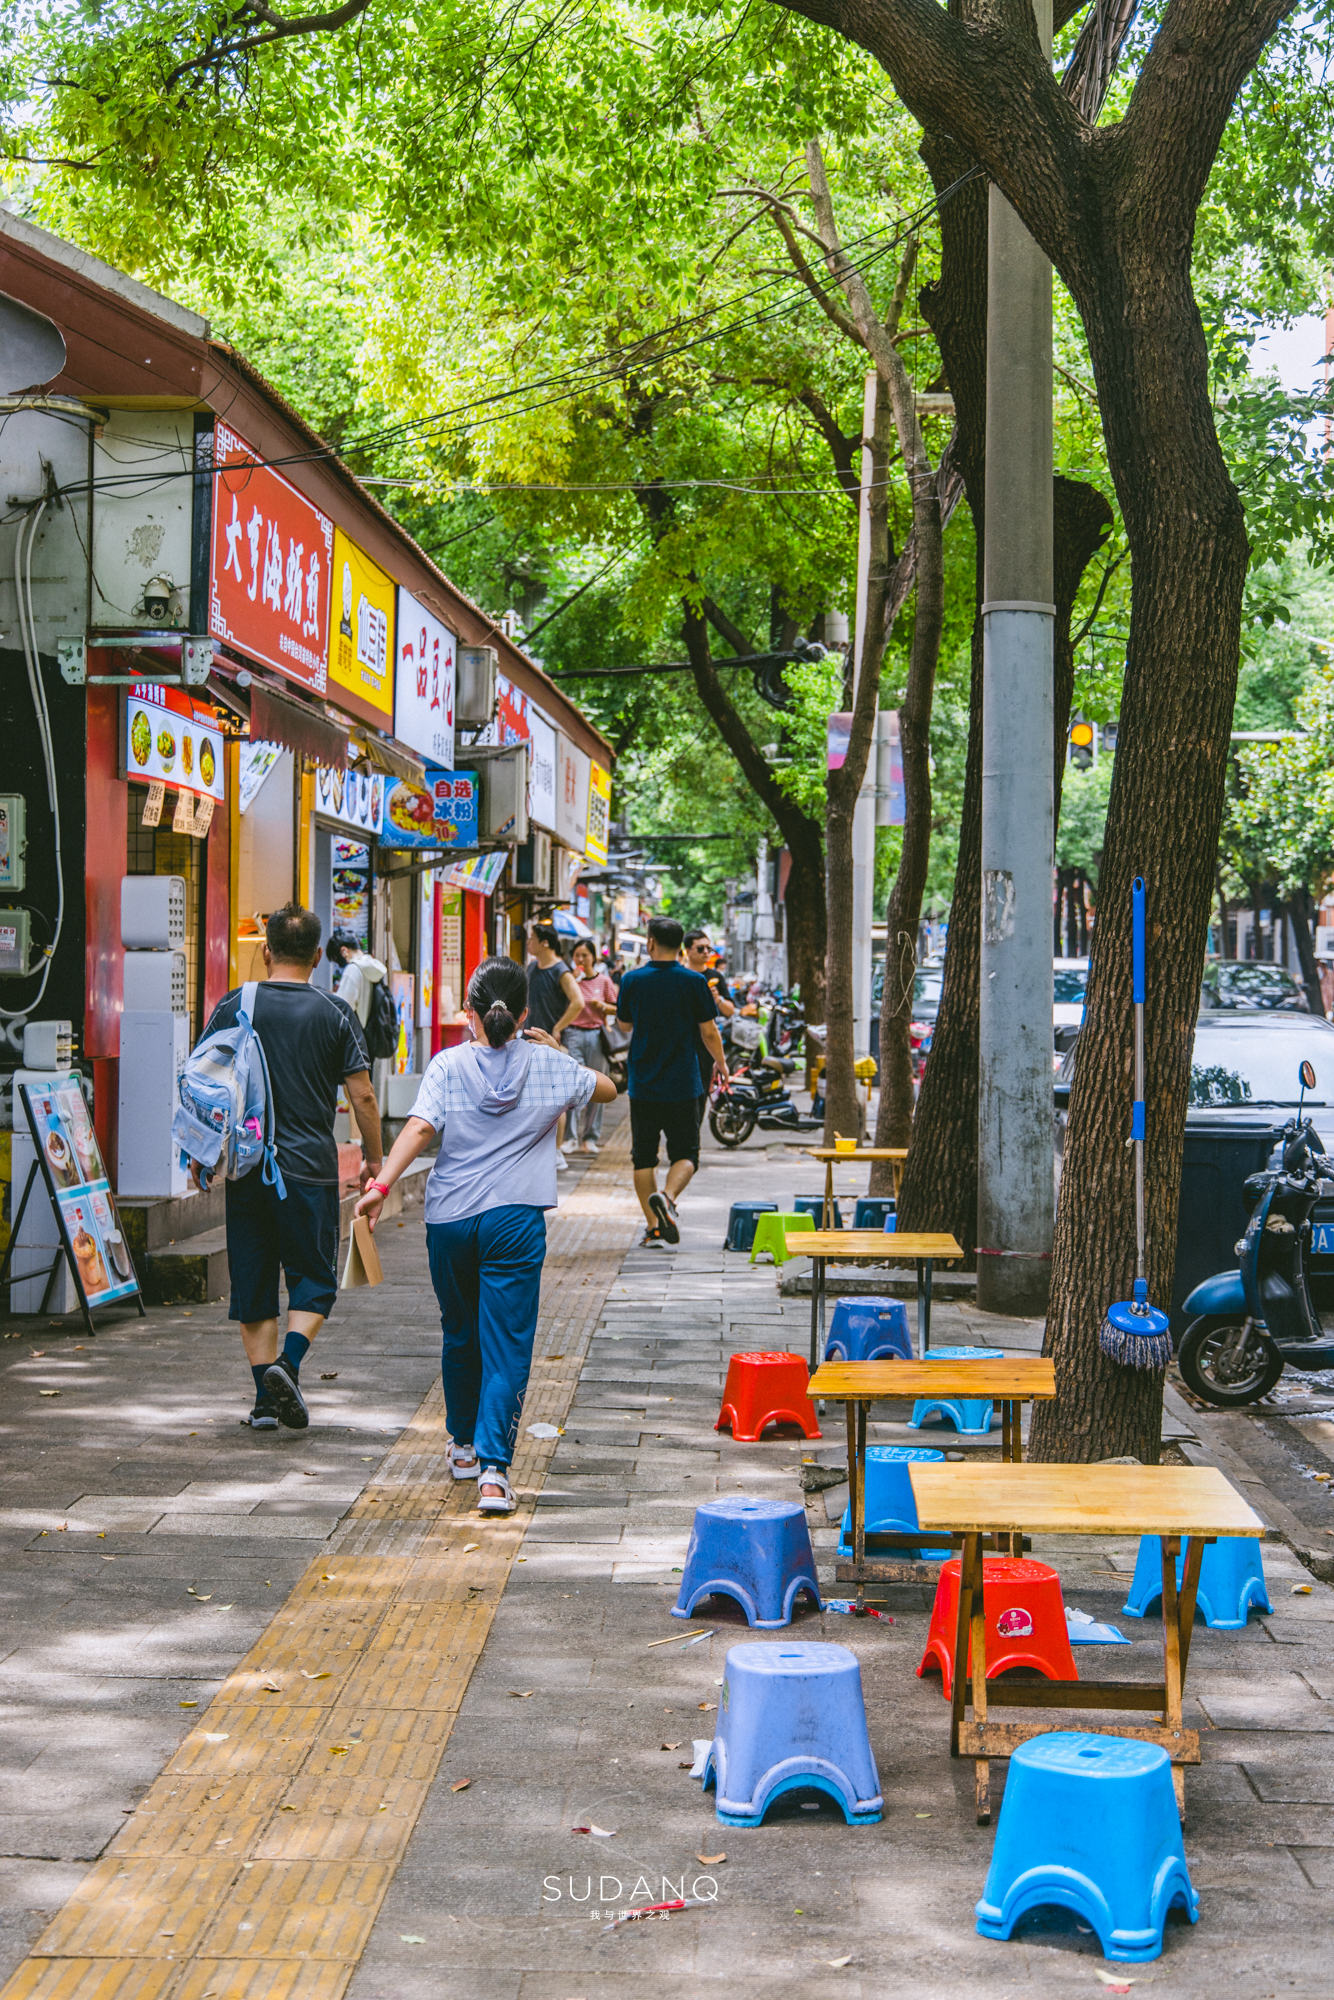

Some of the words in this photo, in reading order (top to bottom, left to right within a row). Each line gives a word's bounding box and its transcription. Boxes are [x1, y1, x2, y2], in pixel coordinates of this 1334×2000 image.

[402, 627, 453, 727] 一品豆花
[434, 779, 473, 799] 自选
[434, 801, 473, 820] 冰粉
